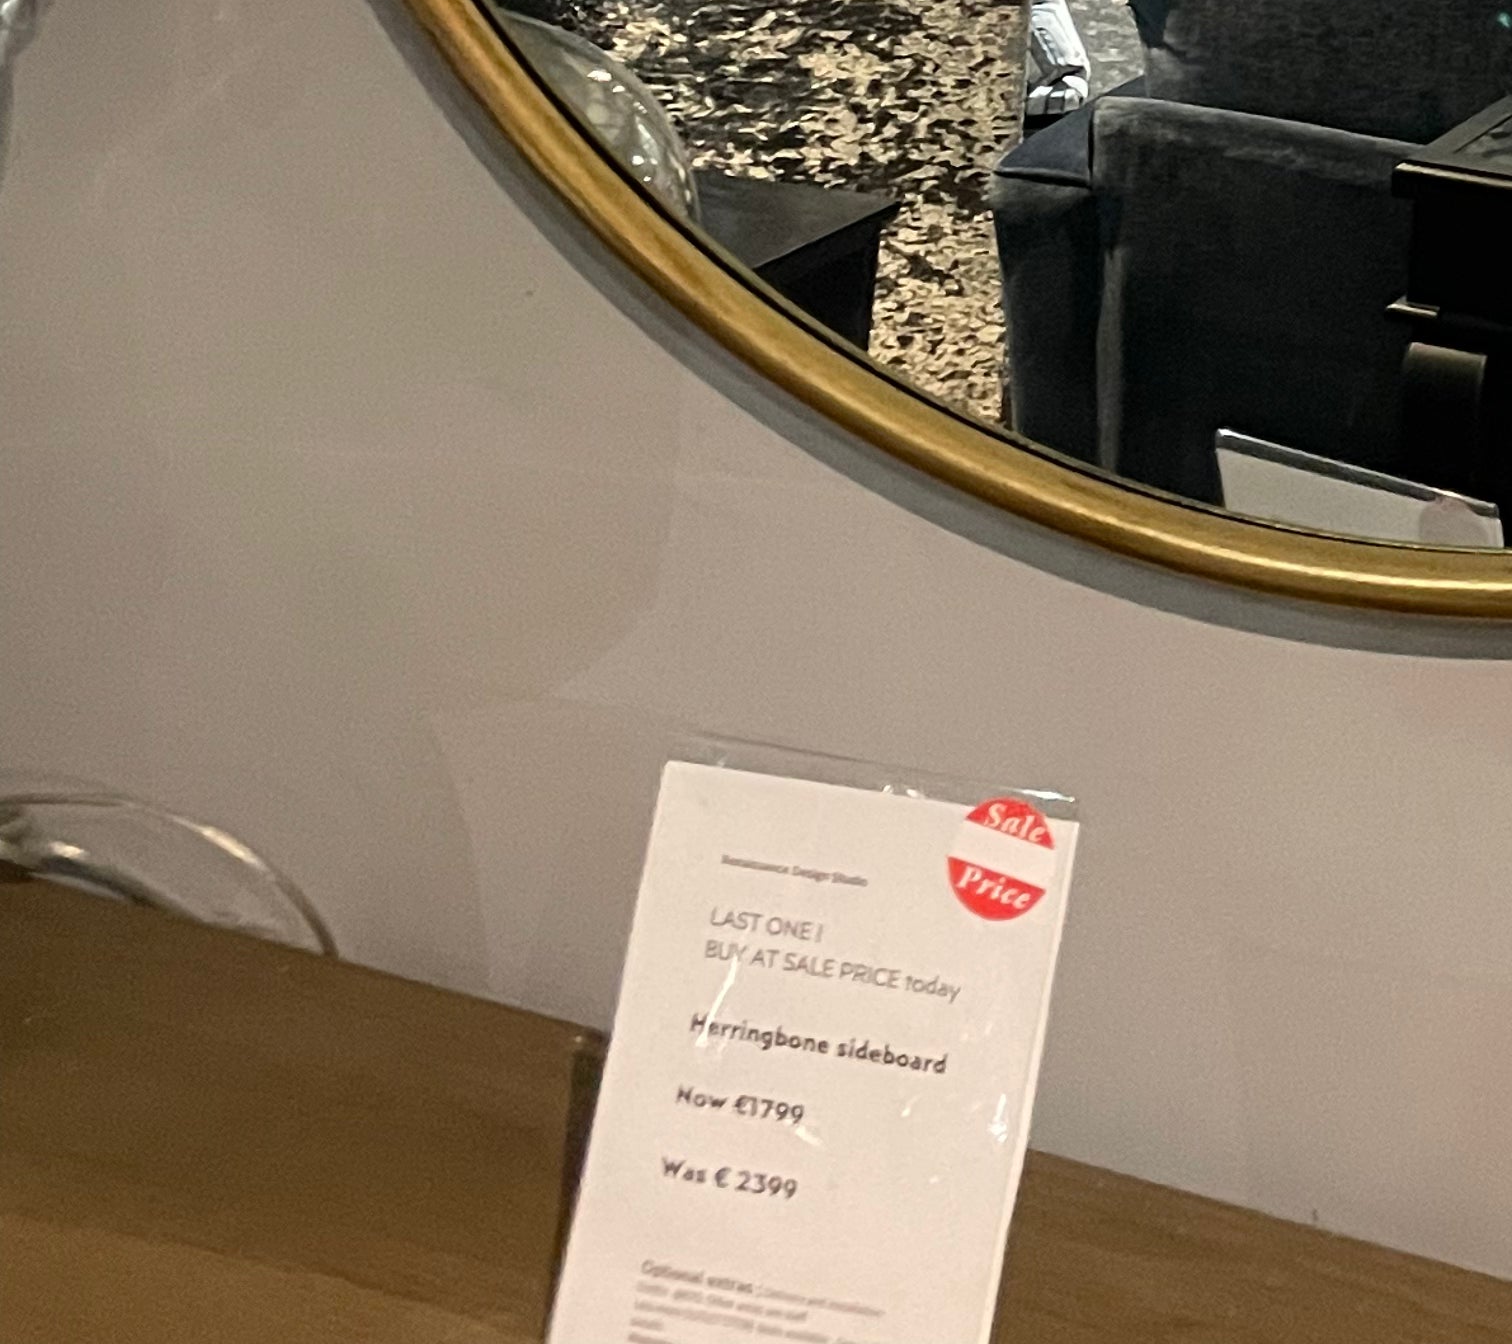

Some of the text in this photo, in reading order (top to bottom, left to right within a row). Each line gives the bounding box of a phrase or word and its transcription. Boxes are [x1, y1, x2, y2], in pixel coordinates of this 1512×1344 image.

[984, 803, 1047, 842] Sale
[957, 865, 1032, 910] Price
[710, 906, 763, 932] LAST
[705, 939, 961, 1004] BUY AT SALE PRICE today
[690, 1012, 949, 1075] Herringbone sideboard
[675, 1084, 805, 1125] Now €1799
[661, 1156, 707, 1184] Was
[735, 1170, 799, 1200] 2399
